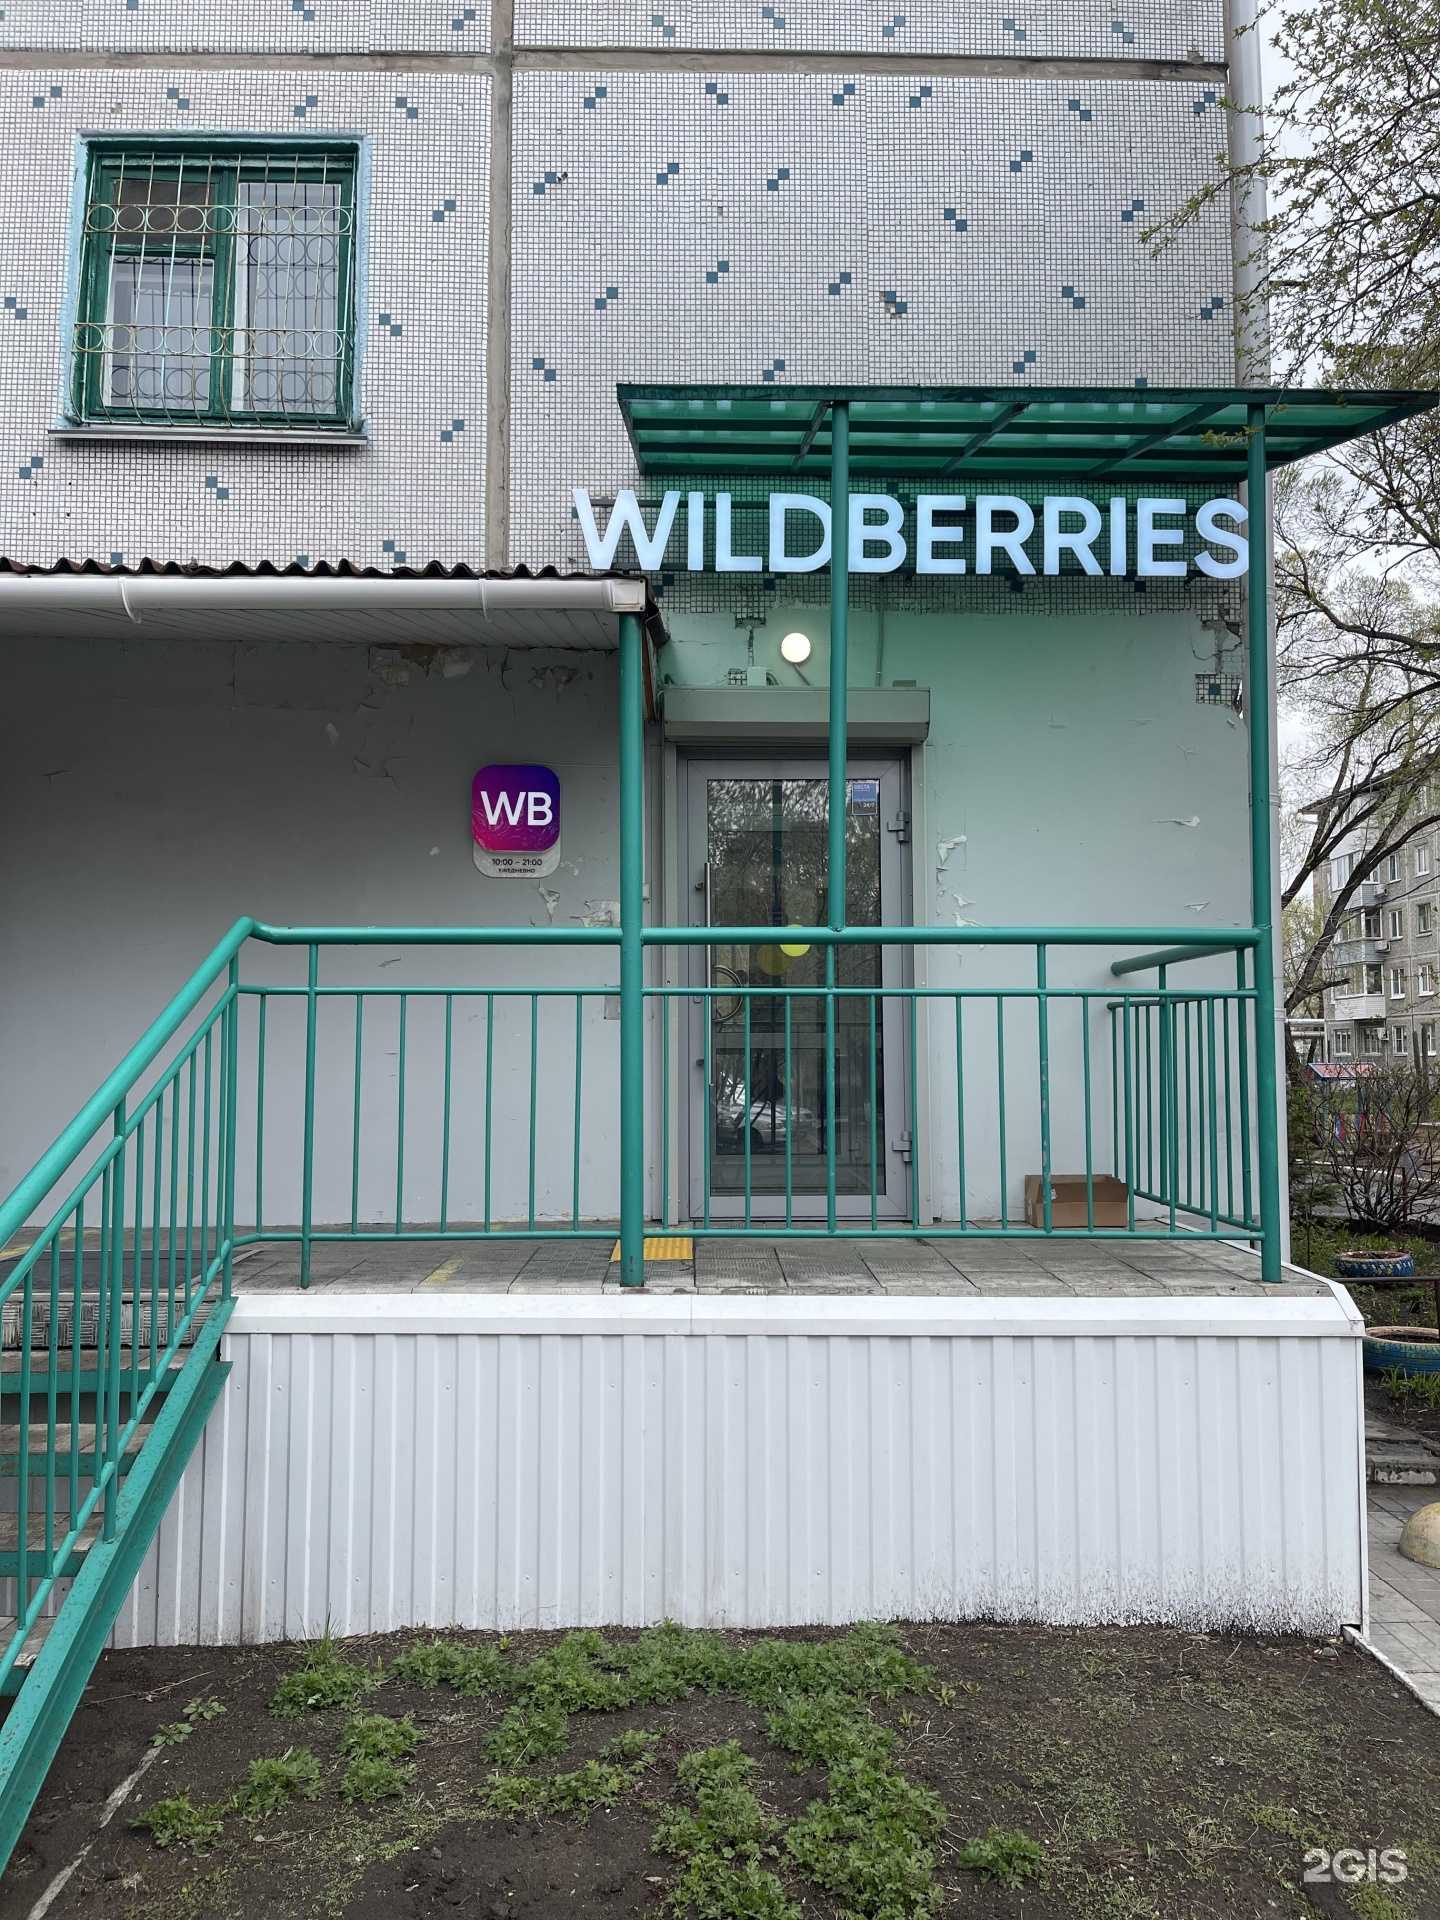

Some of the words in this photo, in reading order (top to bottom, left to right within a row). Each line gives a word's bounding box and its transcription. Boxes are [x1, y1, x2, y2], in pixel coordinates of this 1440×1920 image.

[572, 488, 1249, 579] WILDBERRIES
[480, 791, 553, 826] WB
[491, 858, 513, 866] 10:00
[522, 858, 543, 866] 21:00
